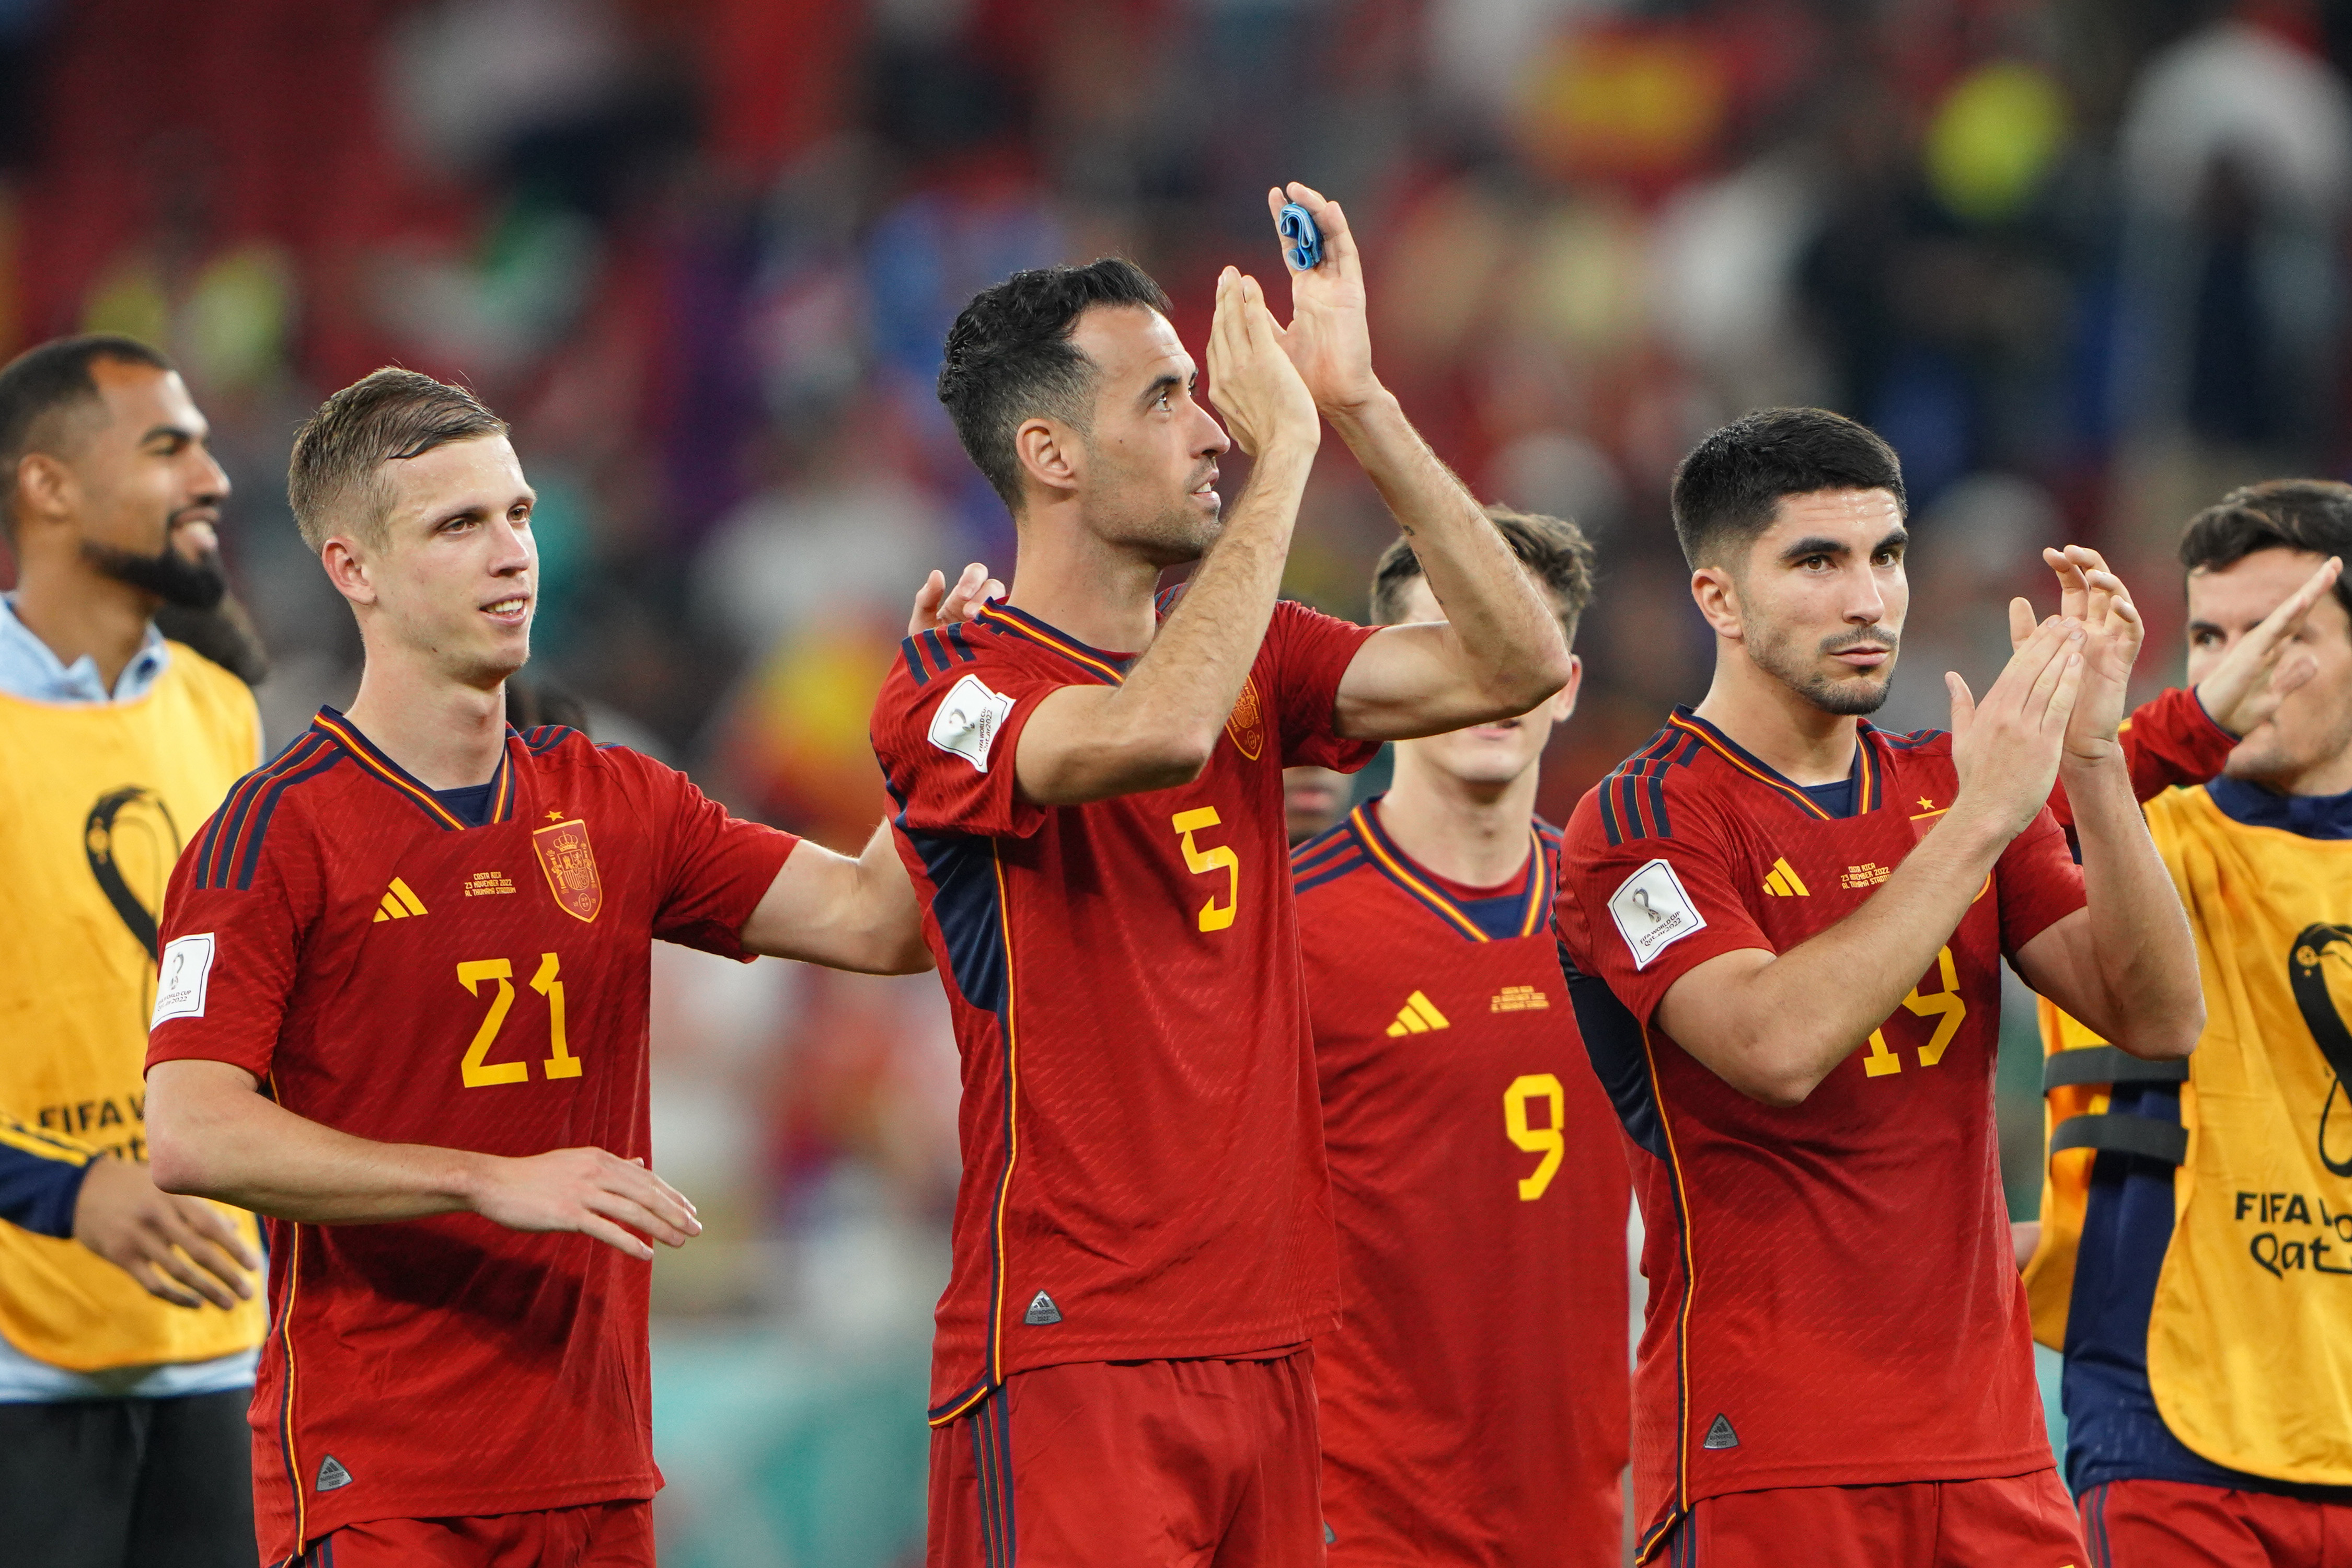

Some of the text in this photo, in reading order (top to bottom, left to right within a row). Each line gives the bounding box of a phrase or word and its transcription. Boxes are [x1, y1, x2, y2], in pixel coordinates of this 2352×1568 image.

[473, 879, 499, 888] NOVEMBER
[1172, 806, 1239, 932] 5
[1861, 862, 1876, 871] RICA
[1870, 874, 1891, 885] STADIU
[1874, 867, 1890, 875] 2022
[1640, 911, 1680, 944] FIFA WORLD CUP
[457, 952, 582, 1088] 21
[39, 1100, 123, 1134] FIFA
[1504, 1073, 1564, 1201] 9
[2235, 1190, 2311, 1224] FIFA
[2250, 1232, 2352, 1281] Qat
